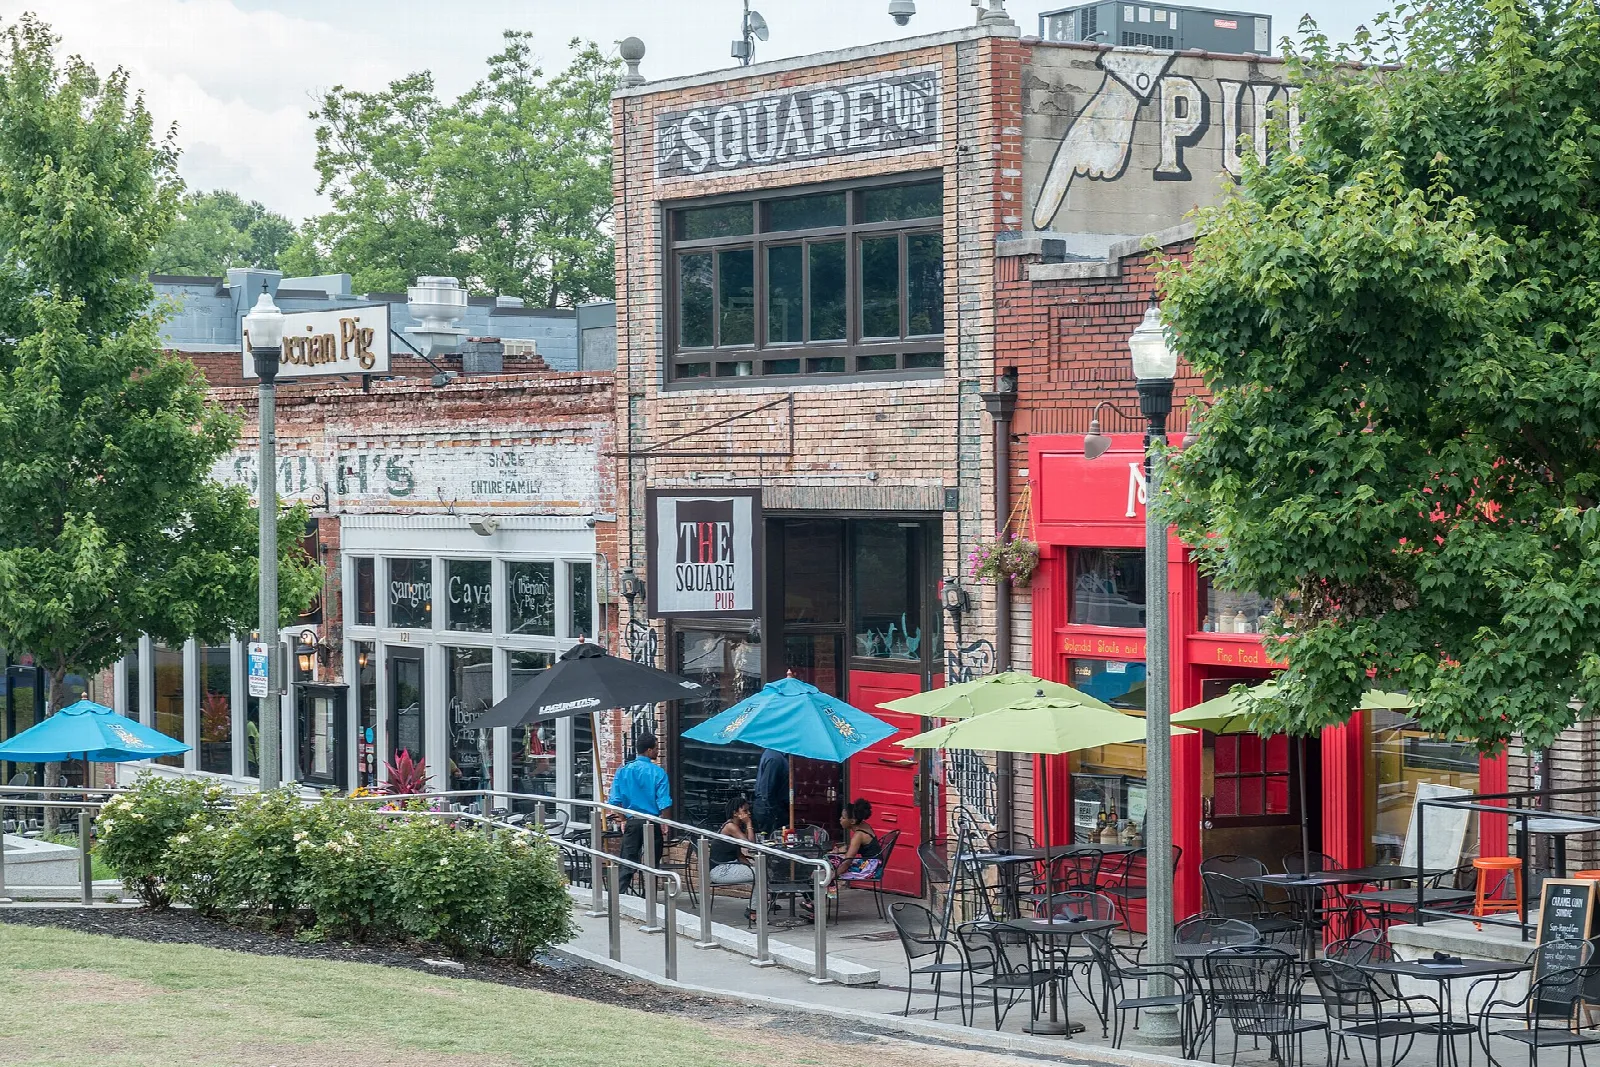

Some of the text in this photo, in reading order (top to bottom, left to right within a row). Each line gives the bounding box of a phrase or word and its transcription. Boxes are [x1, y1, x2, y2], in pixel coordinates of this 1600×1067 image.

[681, 82, 881, 173] SQUARE
[881, 82, 926, 135] PUB
[339, 316, 375, 370] Pig
[471, 480, 542, 494] ENTIRE FAMILY
[680, 521, 731, 564] THE
[518, 577, 545, 596] Iberian
[676, 564, 735, 592] SQUARE
[449, 575, 492, 605] Cava
[524, 594, 536, 611] Pig
[715, 592, 735, 610] PUB
[400, 632, 410, 642] 121
[1064, 637, 1092, 653] Splendid
[1097, 639, 1120, 654] Stouts
[1125, 642, 1138, 654] and
[1217, 647, 1233, 663] Fine
[1238, 648, 1259, 664] Food
[539, 698, 596, 715] LAGUNITAS
[1551, 897, 1584, 908] CARAMEL CORN
